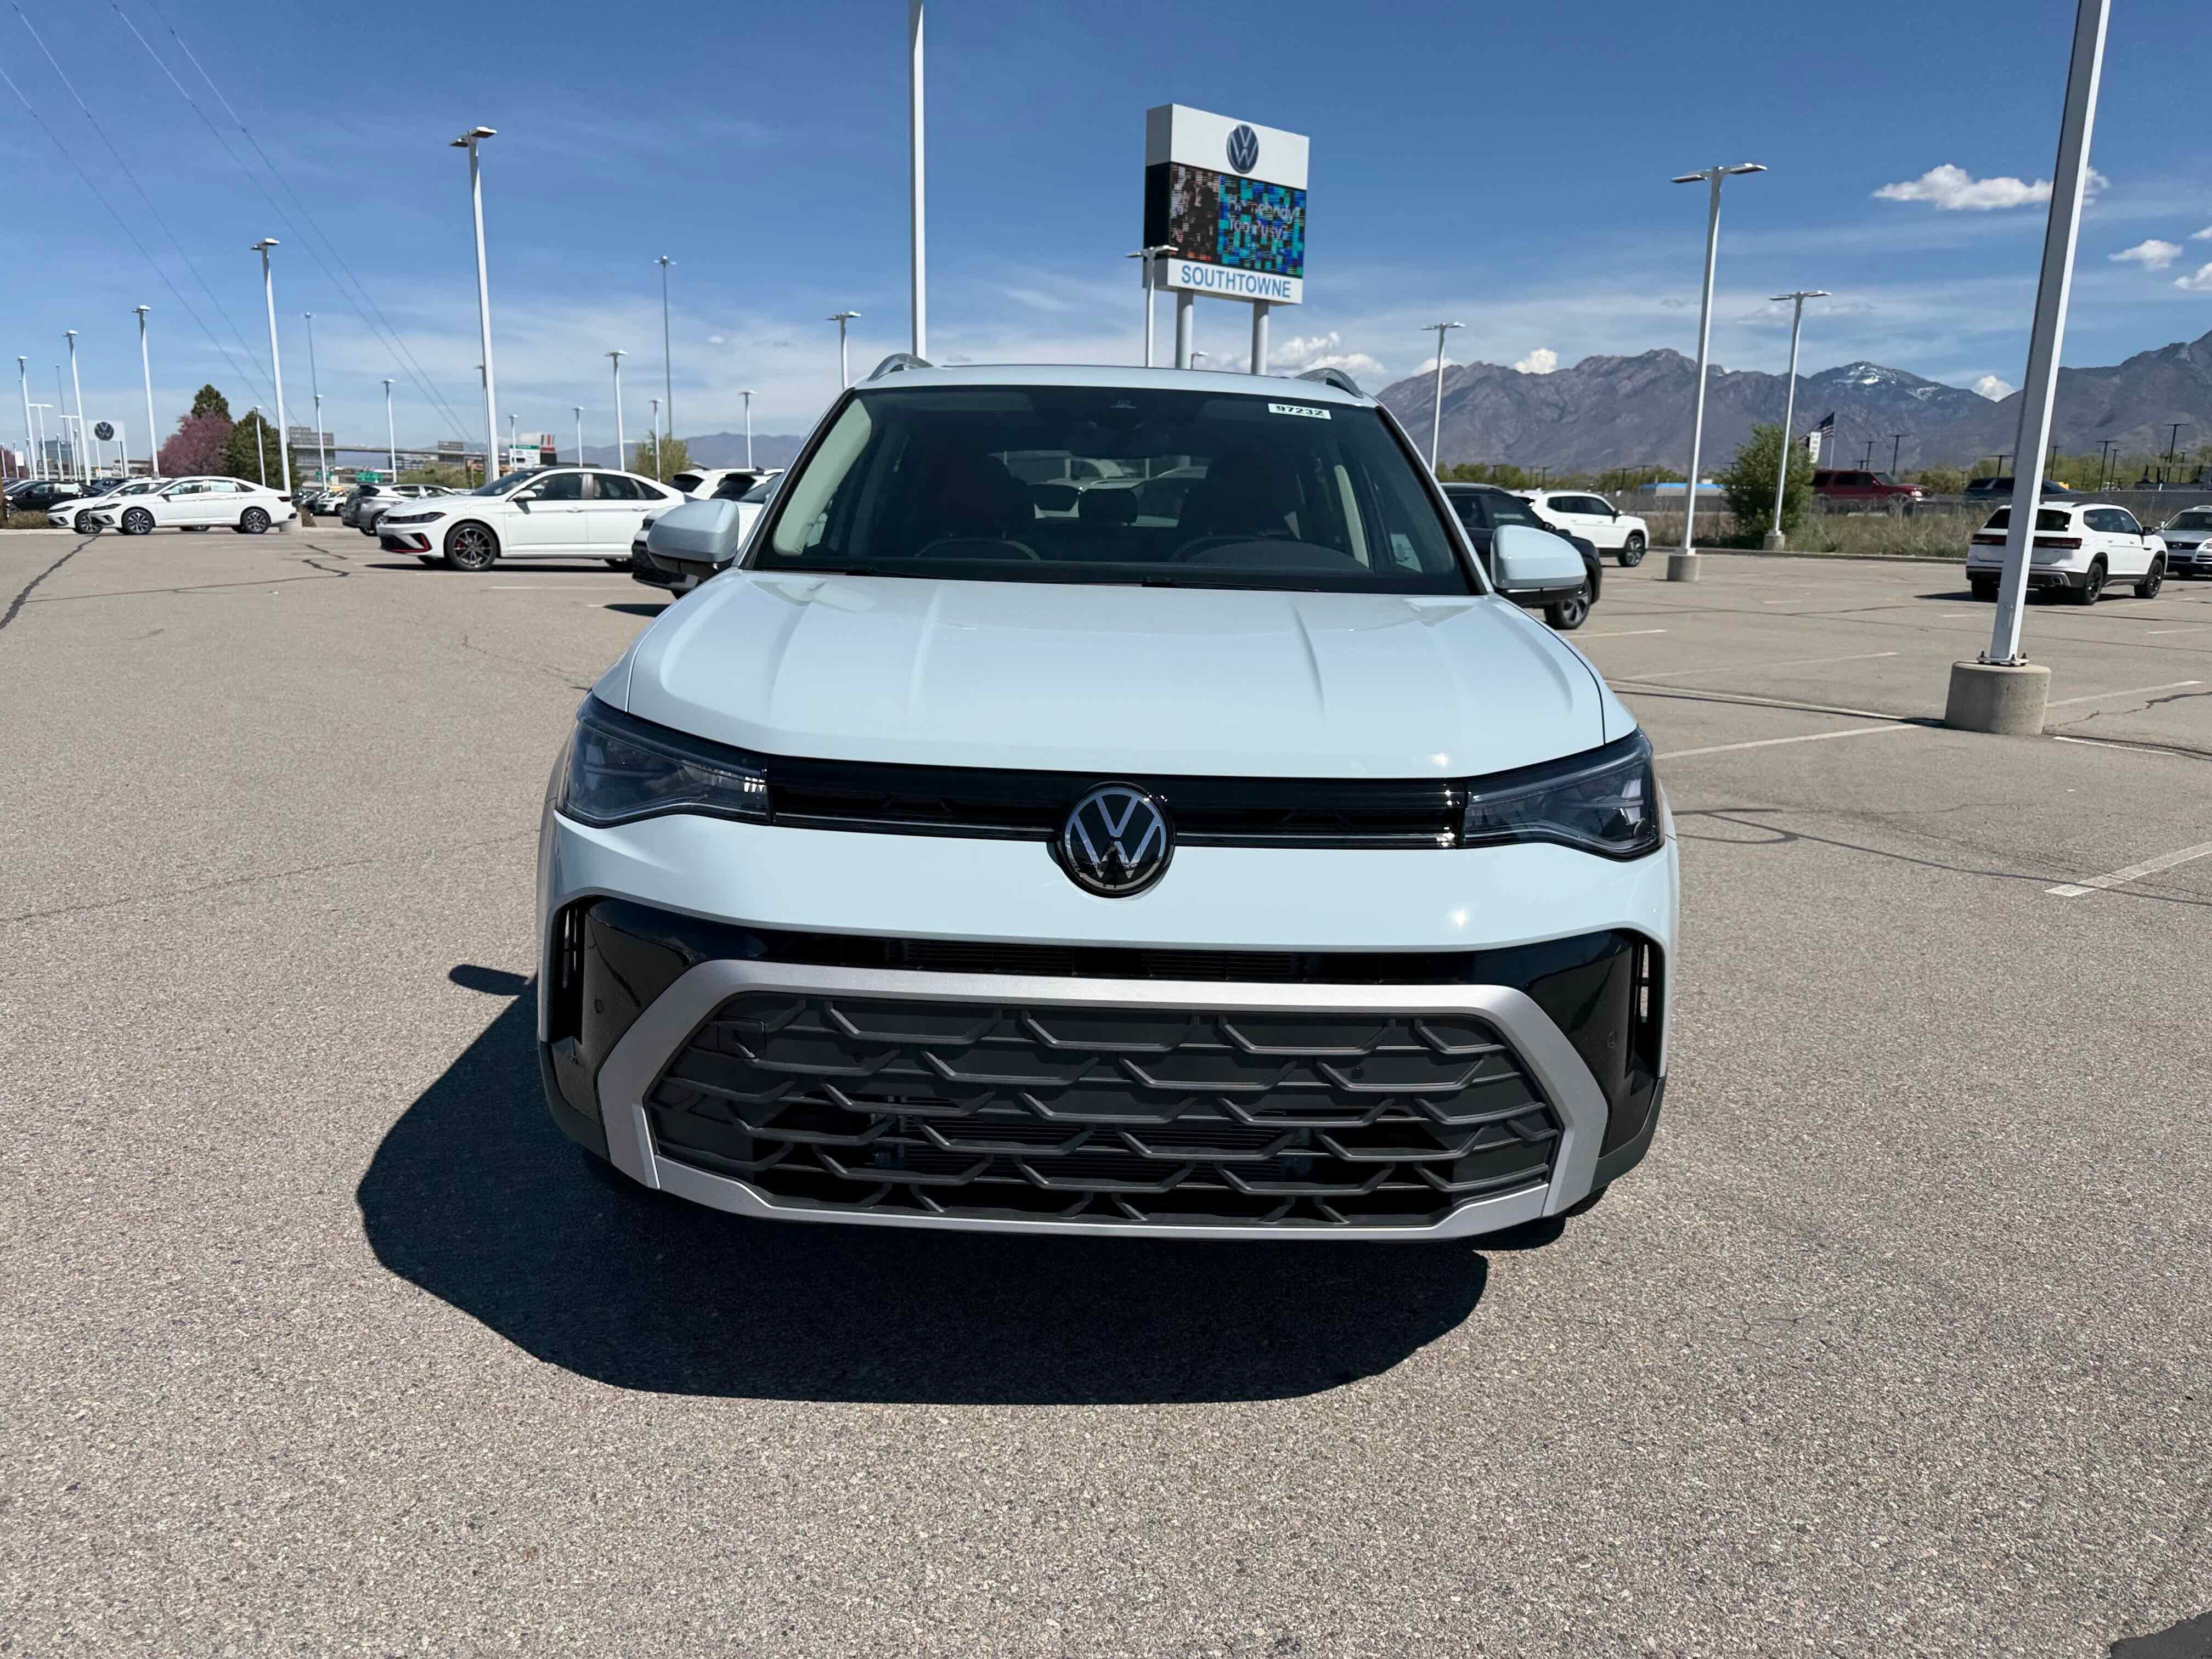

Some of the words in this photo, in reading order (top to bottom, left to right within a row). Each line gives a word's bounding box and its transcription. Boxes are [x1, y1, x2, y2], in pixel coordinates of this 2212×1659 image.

[1228, 125, 1259, 169] VW
[1182, 264, 1291, 298] SOUTHTOWNE
[1276, 405, 1324, 417] 97232
[1066, 789, 1165, 881] VW
